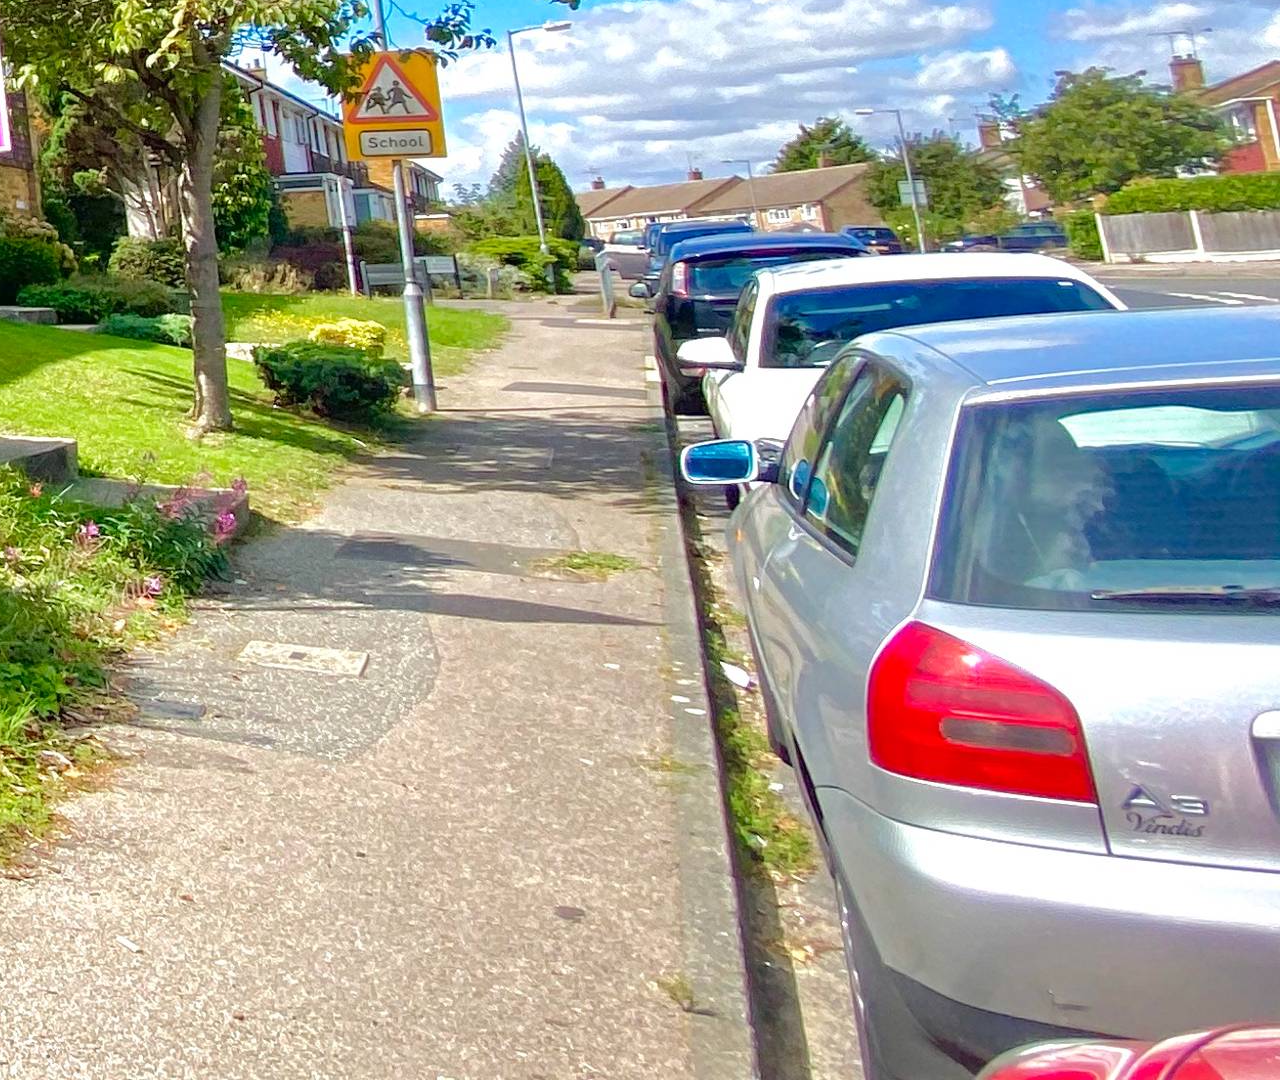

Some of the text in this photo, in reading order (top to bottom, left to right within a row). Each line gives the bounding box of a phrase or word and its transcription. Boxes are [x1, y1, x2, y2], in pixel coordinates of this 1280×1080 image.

[368, 136, 424, 148] School
[1122, 783, 1210, 816] A3
[1126, 811, 1206, 838] Vindis
